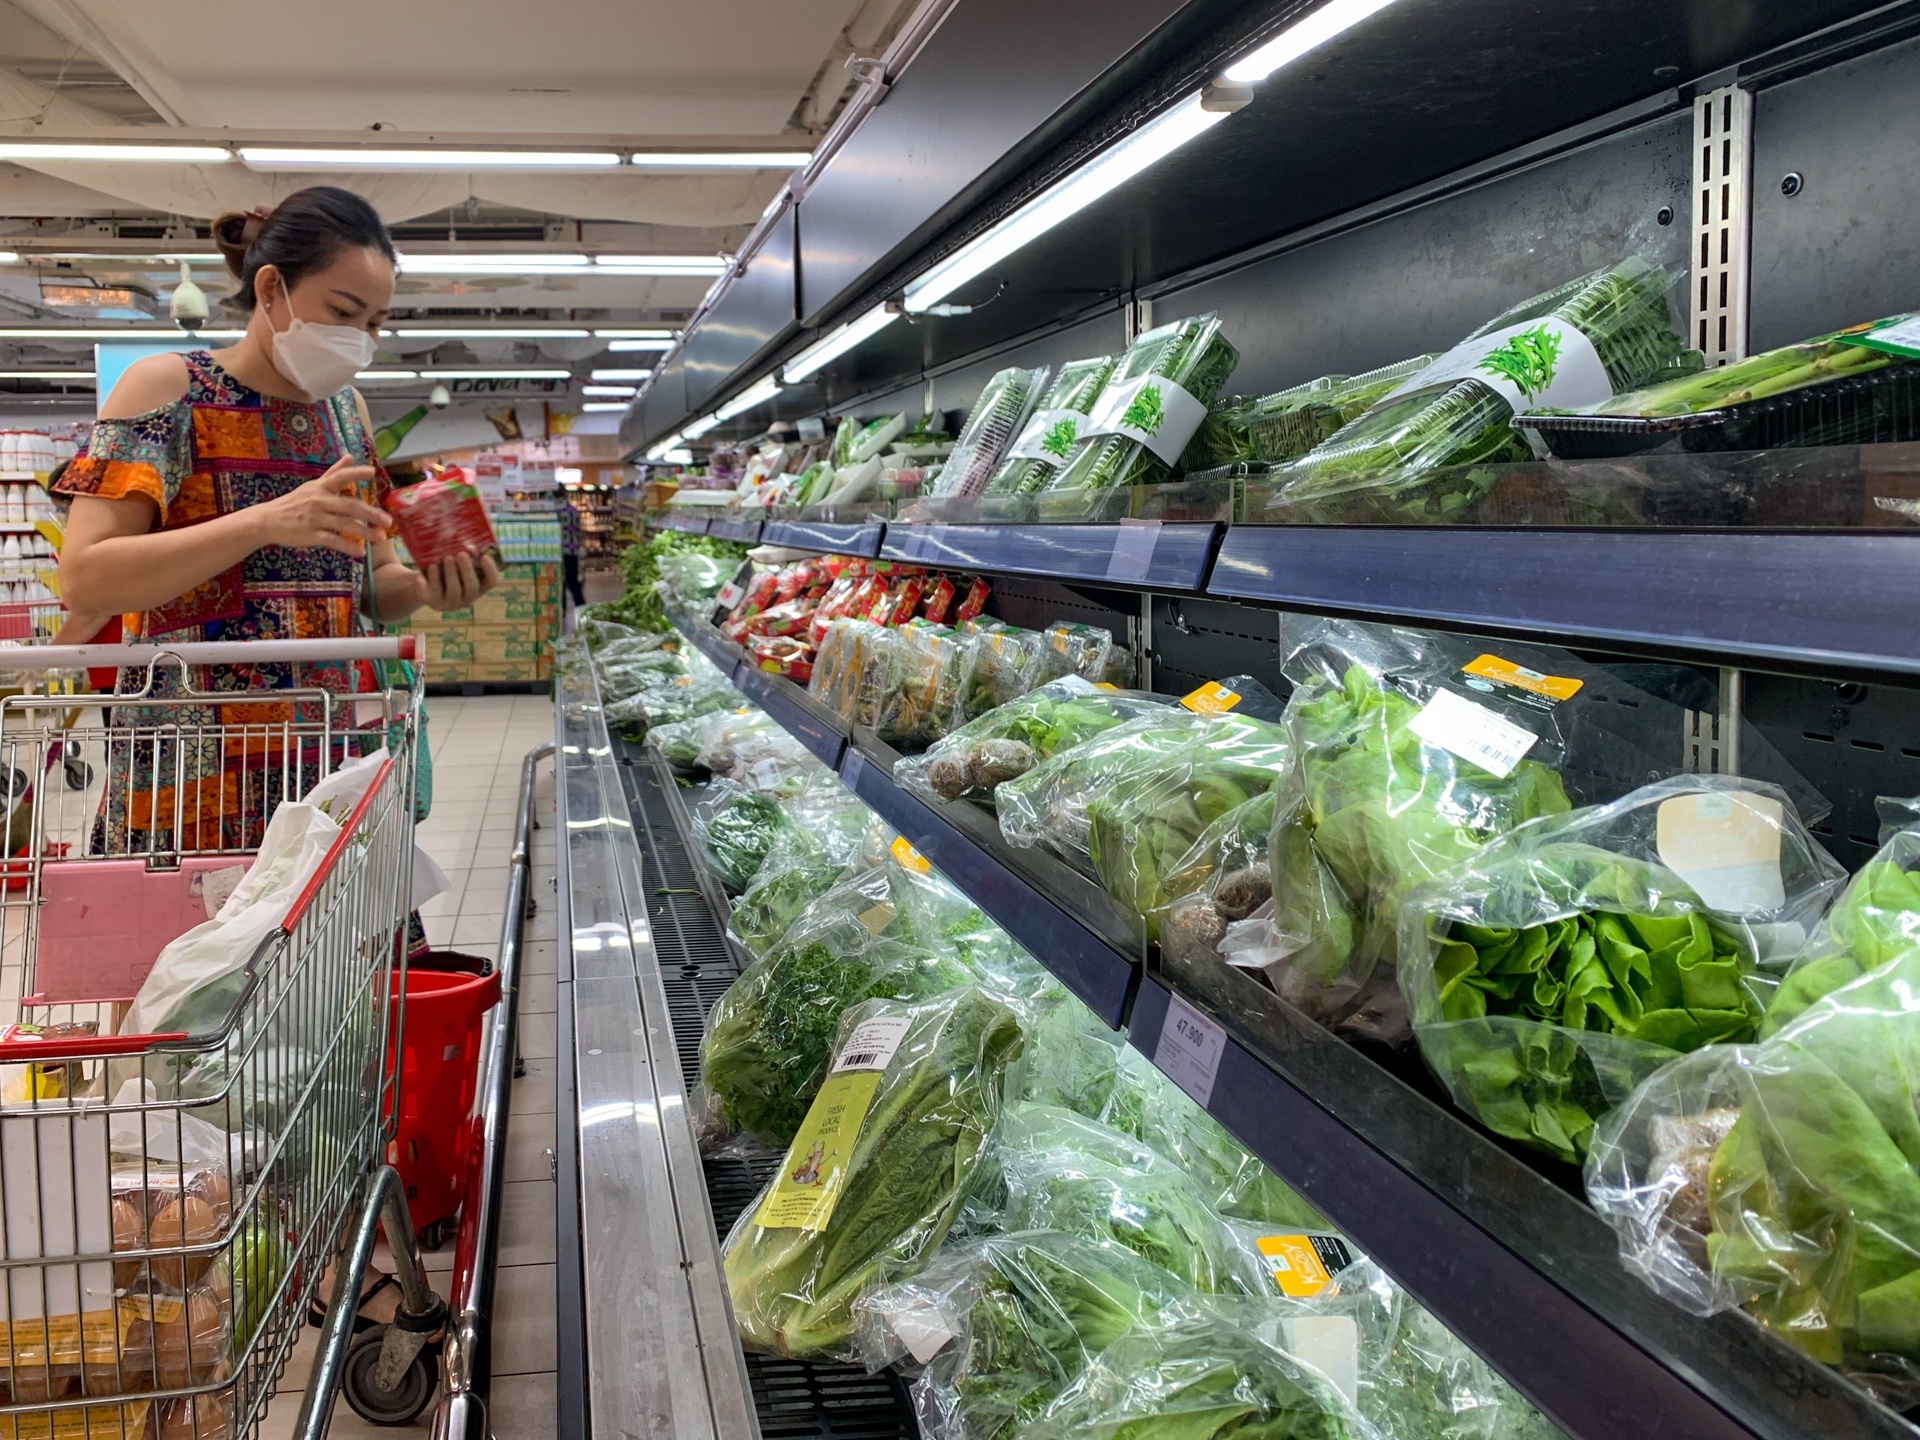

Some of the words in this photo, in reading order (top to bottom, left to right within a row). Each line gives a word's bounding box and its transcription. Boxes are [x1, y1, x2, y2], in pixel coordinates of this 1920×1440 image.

[1176, 1018, 1204, 1047] 47.900
[826, 1104, 846, 1116] FRESH
[822, 1115, 841, 1127] LOCAL
